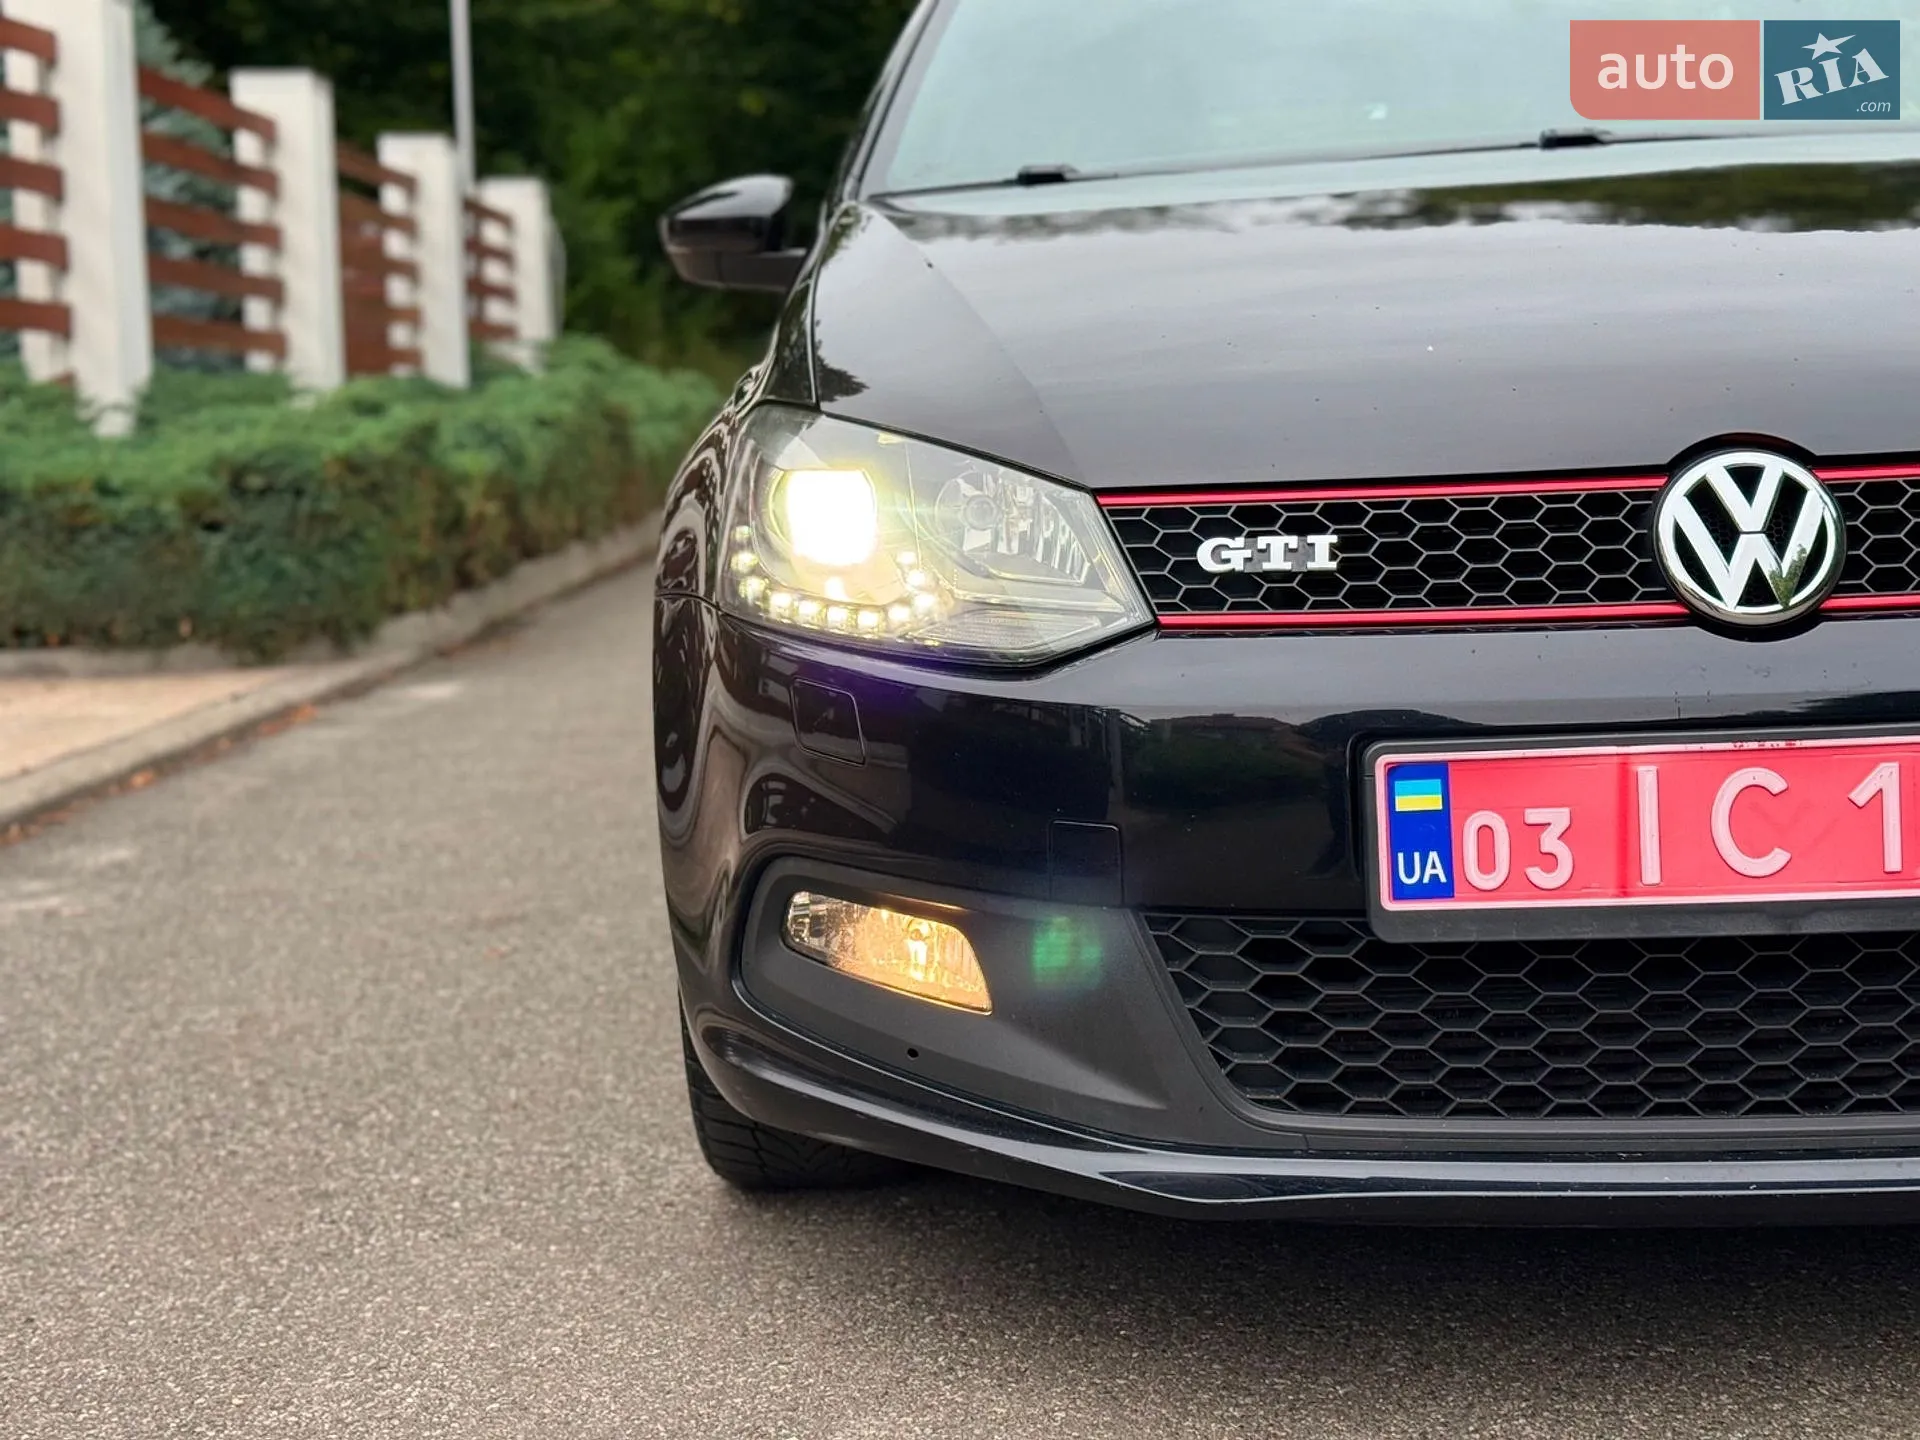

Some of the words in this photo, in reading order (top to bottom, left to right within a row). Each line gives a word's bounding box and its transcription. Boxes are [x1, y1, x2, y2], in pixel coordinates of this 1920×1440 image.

[1196, 534, 1339, 573] GTI
[1397, 851, 1447, 885] UA
[1462, 807, 1574, 891] 03
